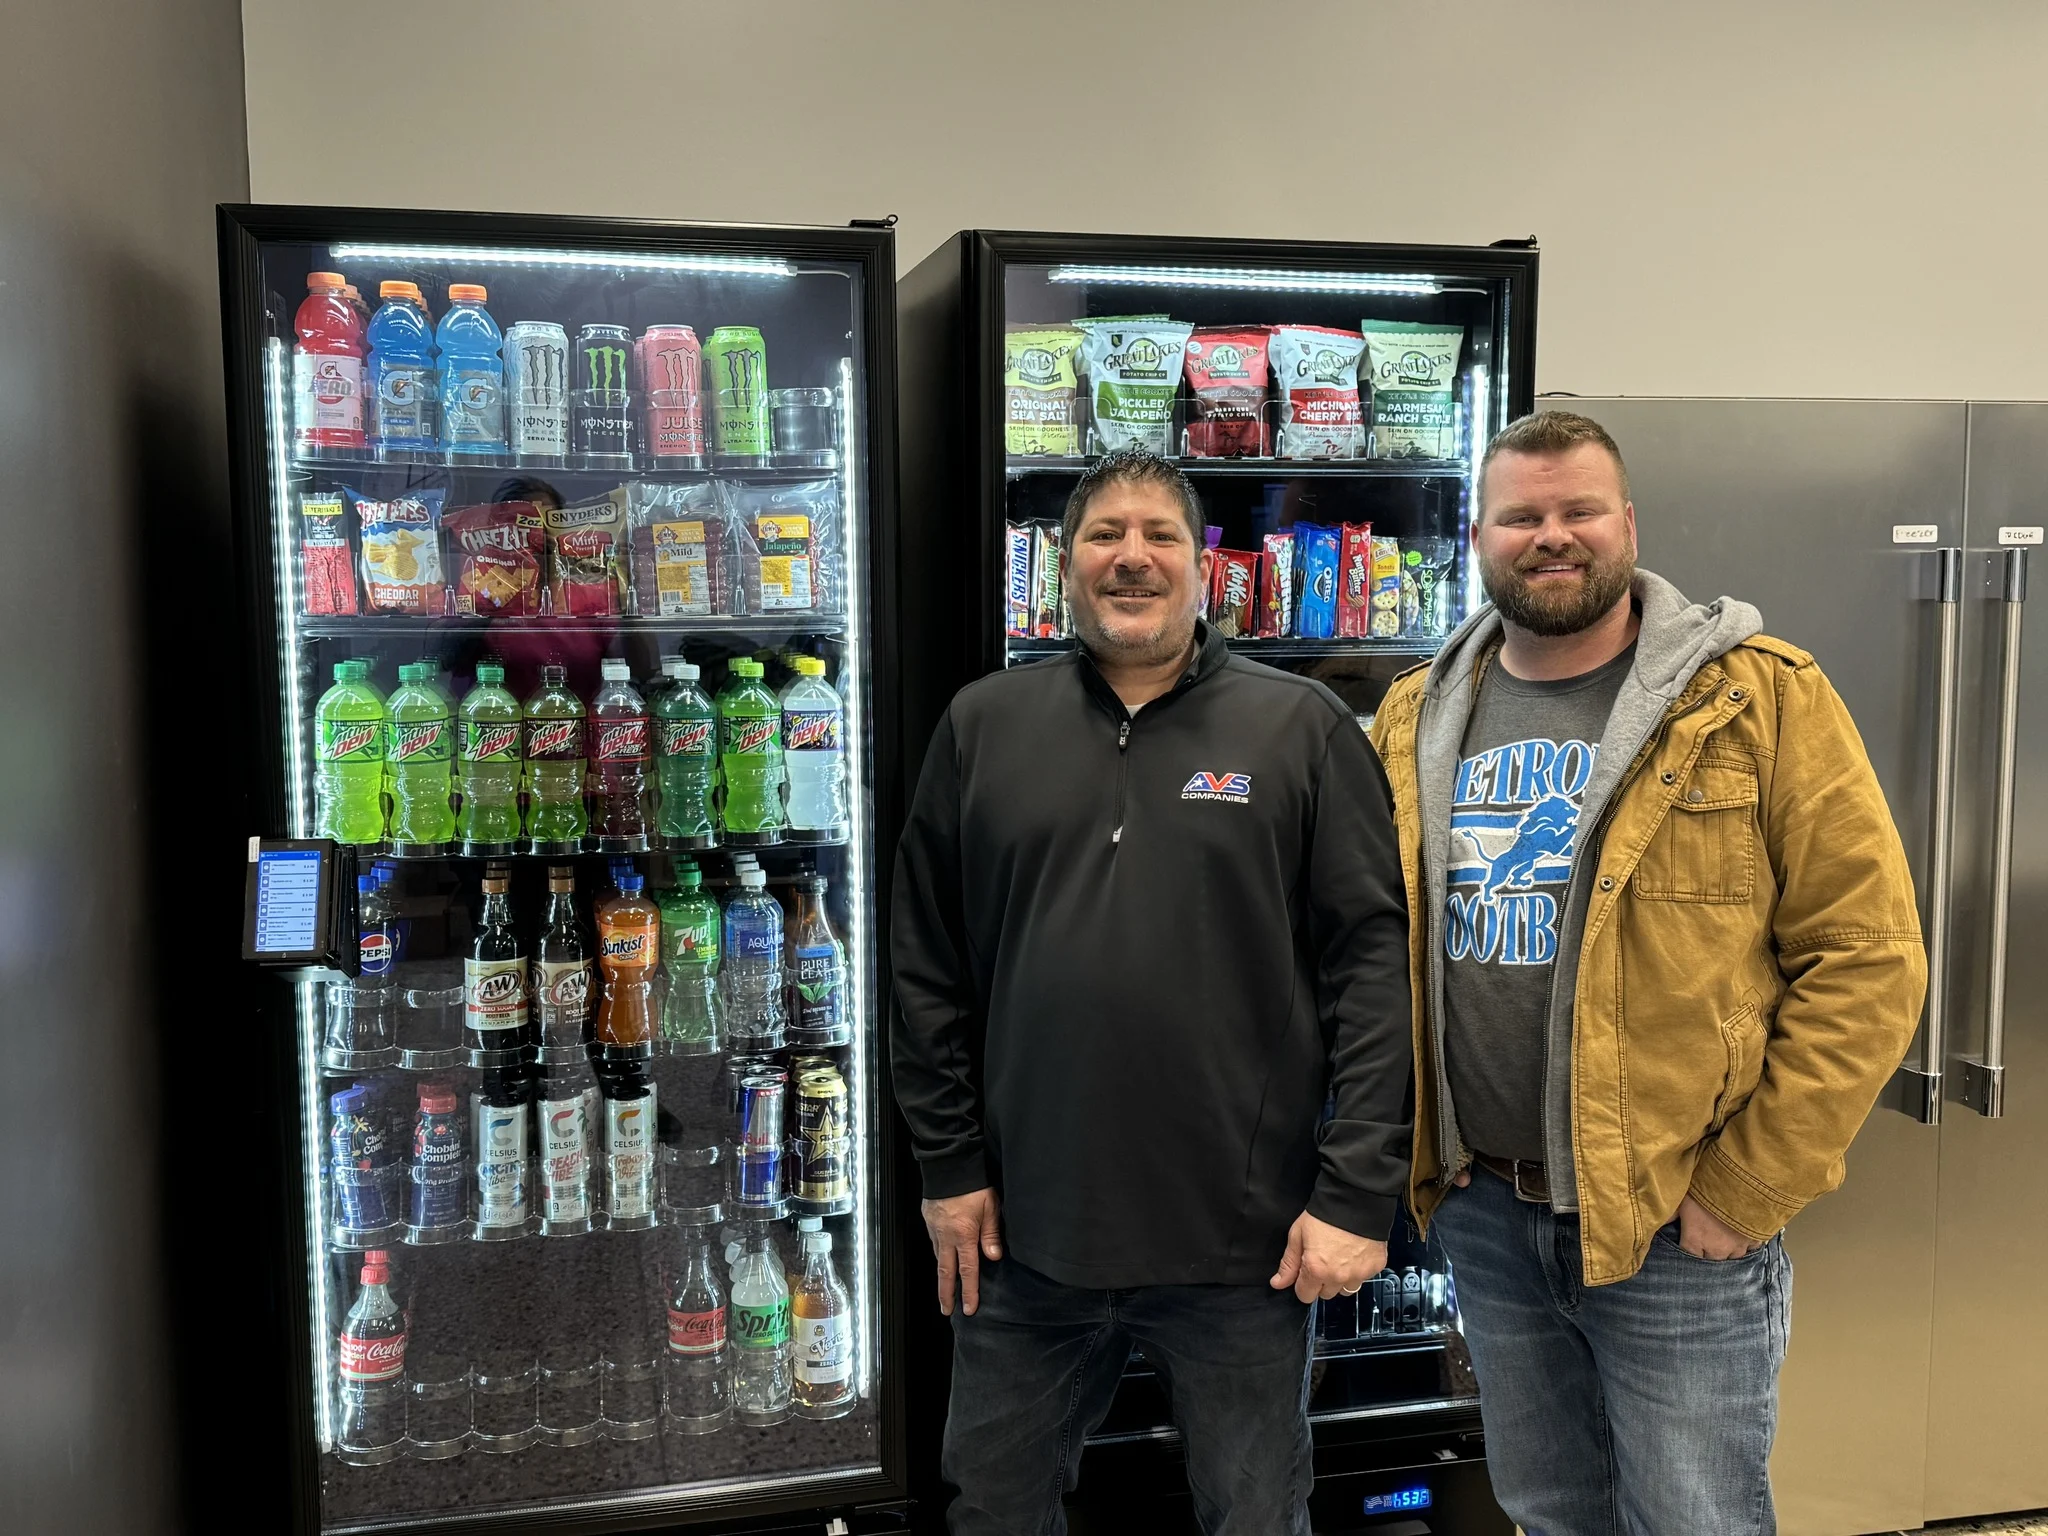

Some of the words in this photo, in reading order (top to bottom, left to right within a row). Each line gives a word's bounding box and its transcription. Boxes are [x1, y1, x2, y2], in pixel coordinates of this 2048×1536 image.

[1142, 342, 1181, 364] LAKES
[1011, 400, 1067, 411] ORIGINAL
[1118, 398, 1165, 408] PICKLED
[1307, 400, 1358, 410] MICHIGAN
[1011, 410, 1036, 420] SEA
[1040, 411, 1067, 420] SALT
[1110, 409, 1171, 420] JALAPEÑO
[1300, 411, 1343, 421] CHERRY
[1378, 413, 1420, 423] RANCH
[1422, 414, 1451, 424] STYLE
[581, 416, 634, 430] MONSTER
[662, 416, 703, 429] JUICE
[551, 505, 612, 523] SNYDER'S
[572, 535, 598, 546] Mini
[763, 541, 802, 551] Jalapeño
[670, 548, 693, 557] Mild
[1011, 535, 1028, 603] SNICKERS
[1041, 545, 1060, 582] Milky
[1322, 566, 1333, 603] OREO
[375, 588, 419, 600] CHEDDAR
[1453, 738, 1600, 805] ETRO
[1183, 771, 1252, 795] AVS
[1181, 792, 1249, 804] COMPANIES
[601, 934, 646, 957] Sunkist
[360, 946, 392, 959] PEPSI
[801, 958, 831, 970] PURE
[482, 974, 512, 1000] A&W
[550, 1150, 583, 1171] PEACH
